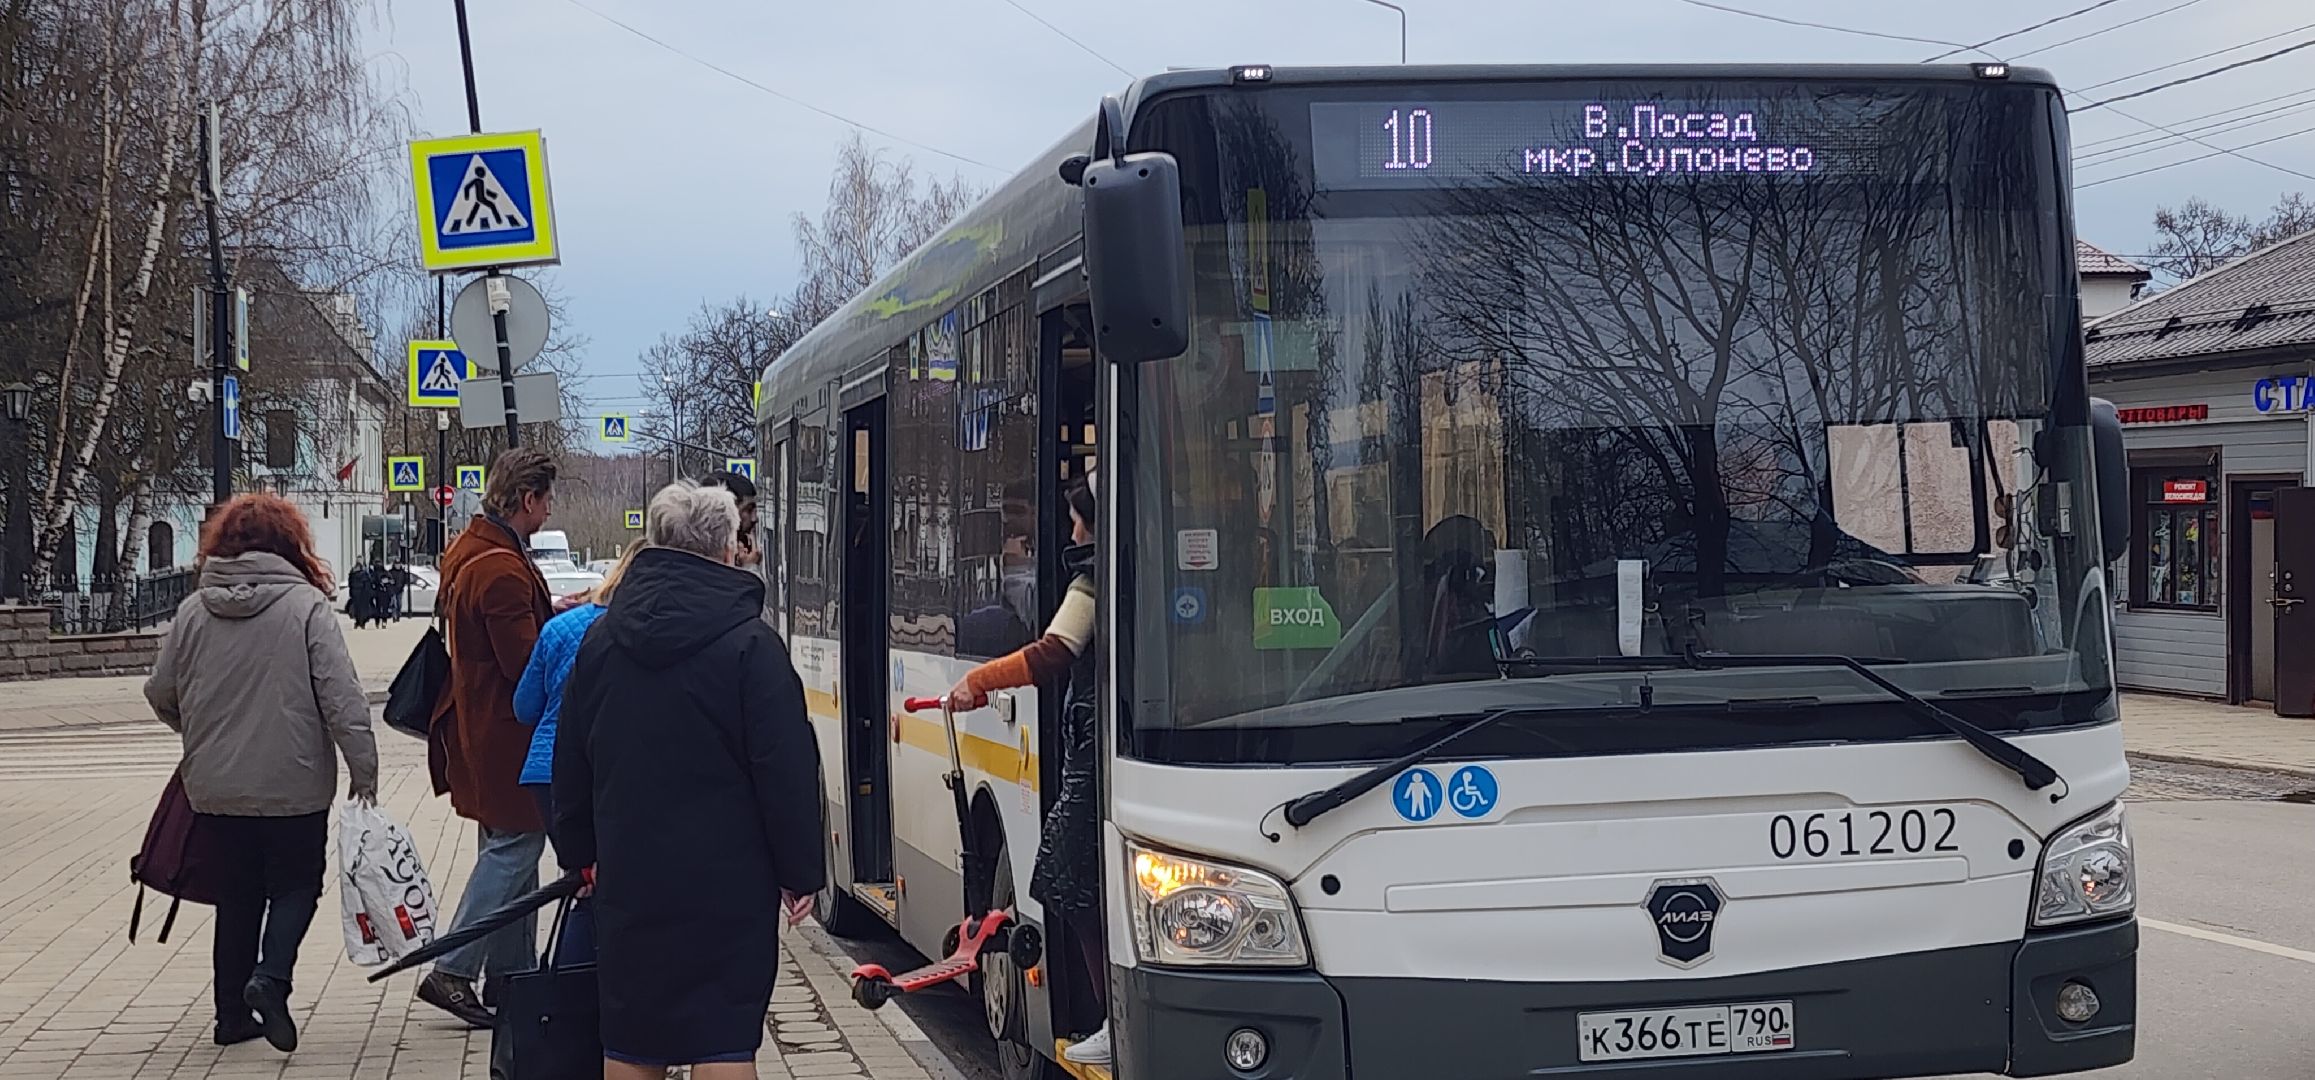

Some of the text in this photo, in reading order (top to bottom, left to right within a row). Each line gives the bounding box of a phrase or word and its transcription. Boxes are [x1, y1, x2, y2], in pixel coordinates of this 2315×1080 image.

[1384, 110, 1431, 169] 10
[1270, 608, 1324, 627] ВХОД
[1769, 808, 1958, 859] 061202
[1658, 910, 1713, 924] ЛИАЗ
[1733, 1006, 1785, 1036] 790
[1747, 1035, 1771, 1047] RUS
